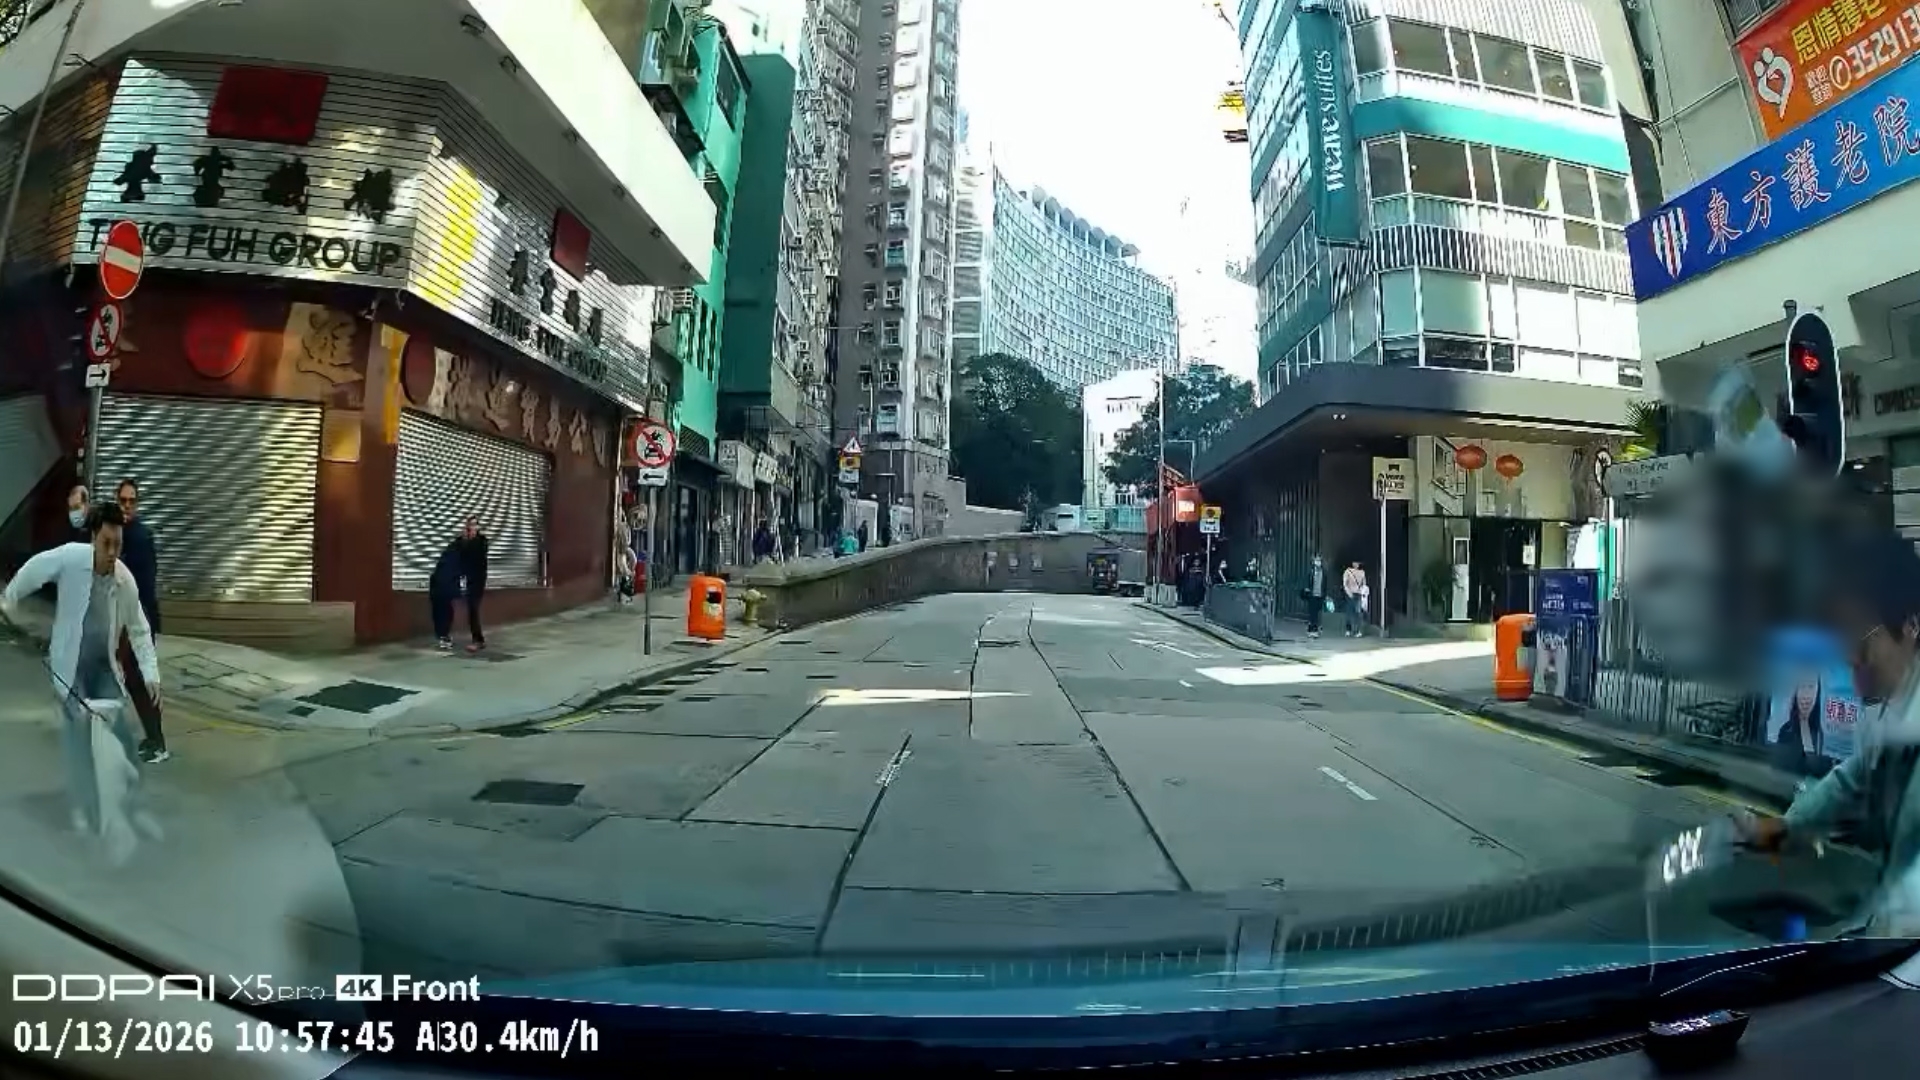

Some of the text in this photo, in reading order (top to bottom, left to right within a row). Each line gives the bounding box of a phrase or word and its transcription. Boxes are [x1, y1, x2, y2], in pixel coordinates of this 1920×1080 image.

[1706, 95, 1920, 255] 東方護老院
[88, 217, 401, 276] TG FUH GROUP
